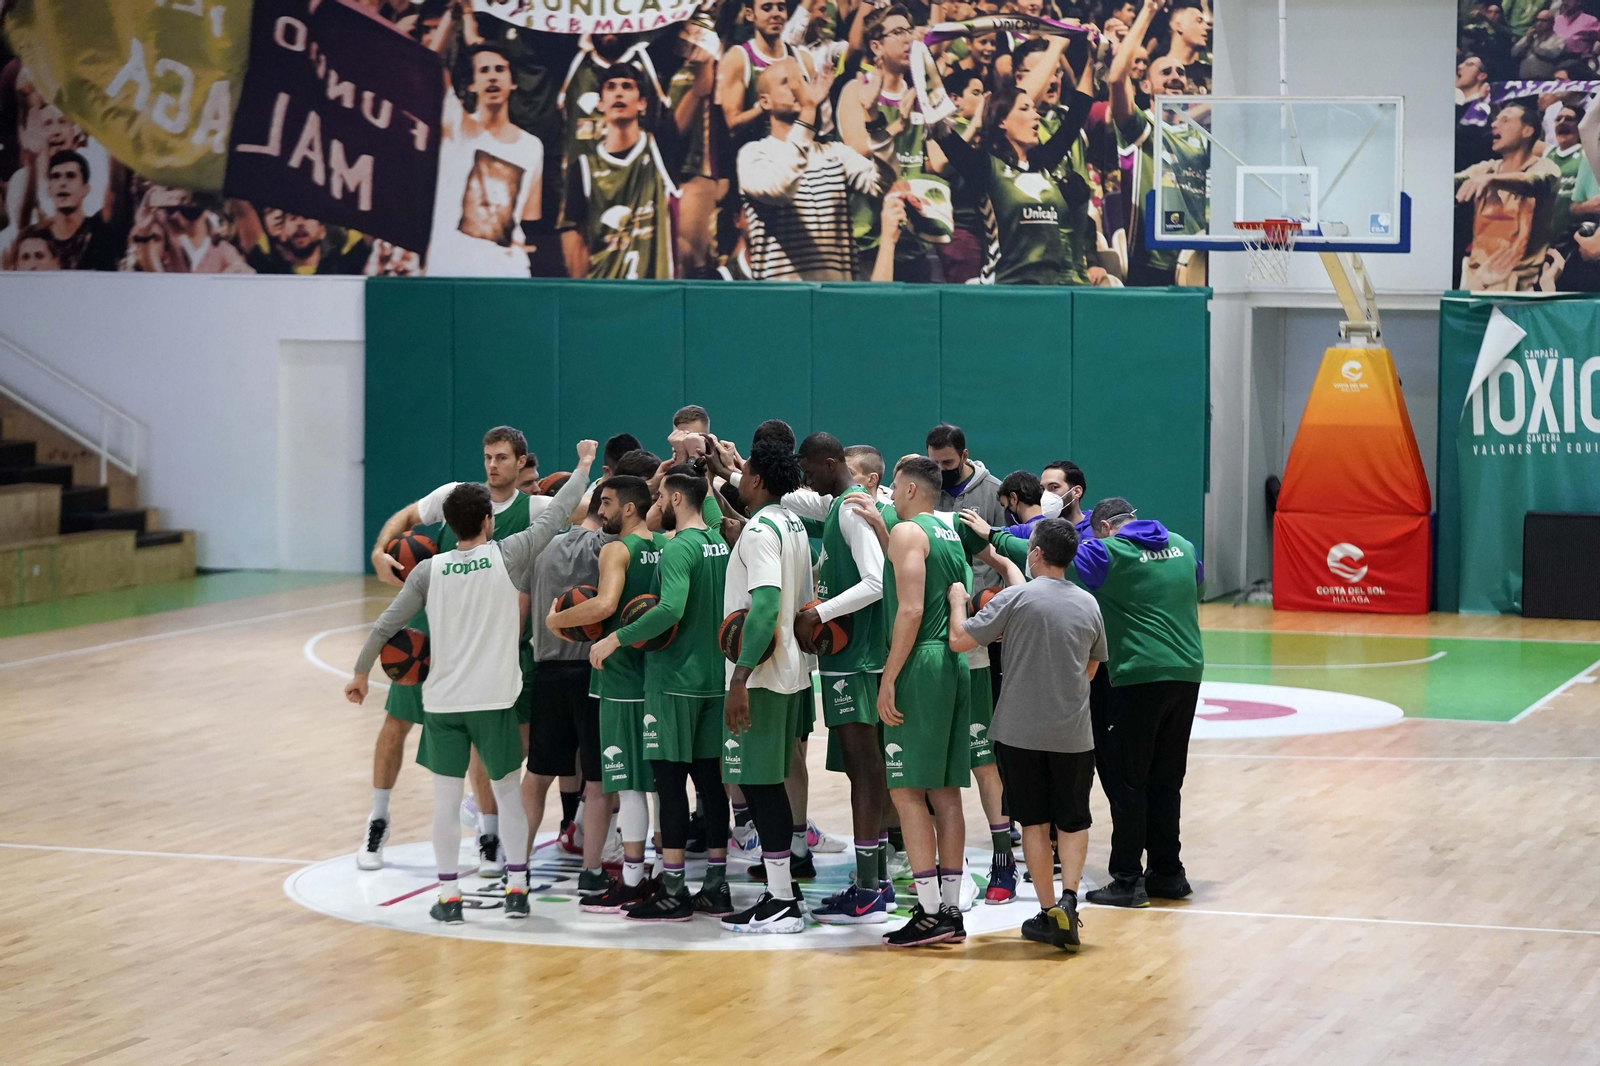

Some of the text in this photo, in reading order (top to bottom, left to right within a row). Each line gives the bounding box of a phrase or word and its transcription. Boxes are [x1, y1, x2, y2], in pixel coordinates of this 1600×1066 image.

[1022, 205, 1058, 221] Unicaja
[1524, 348, 1559, 359] CAMPAÑA
[1526, 433, 1561, 443] CANTERA
[1473, 442, 1600, 456] VALORES EN EQUI
[1139, 546, 1184, 563] Joma
[1316, 585, 1386, 596] COSTA DEL SOL
[834, 695, 852, 704] Unicaja
